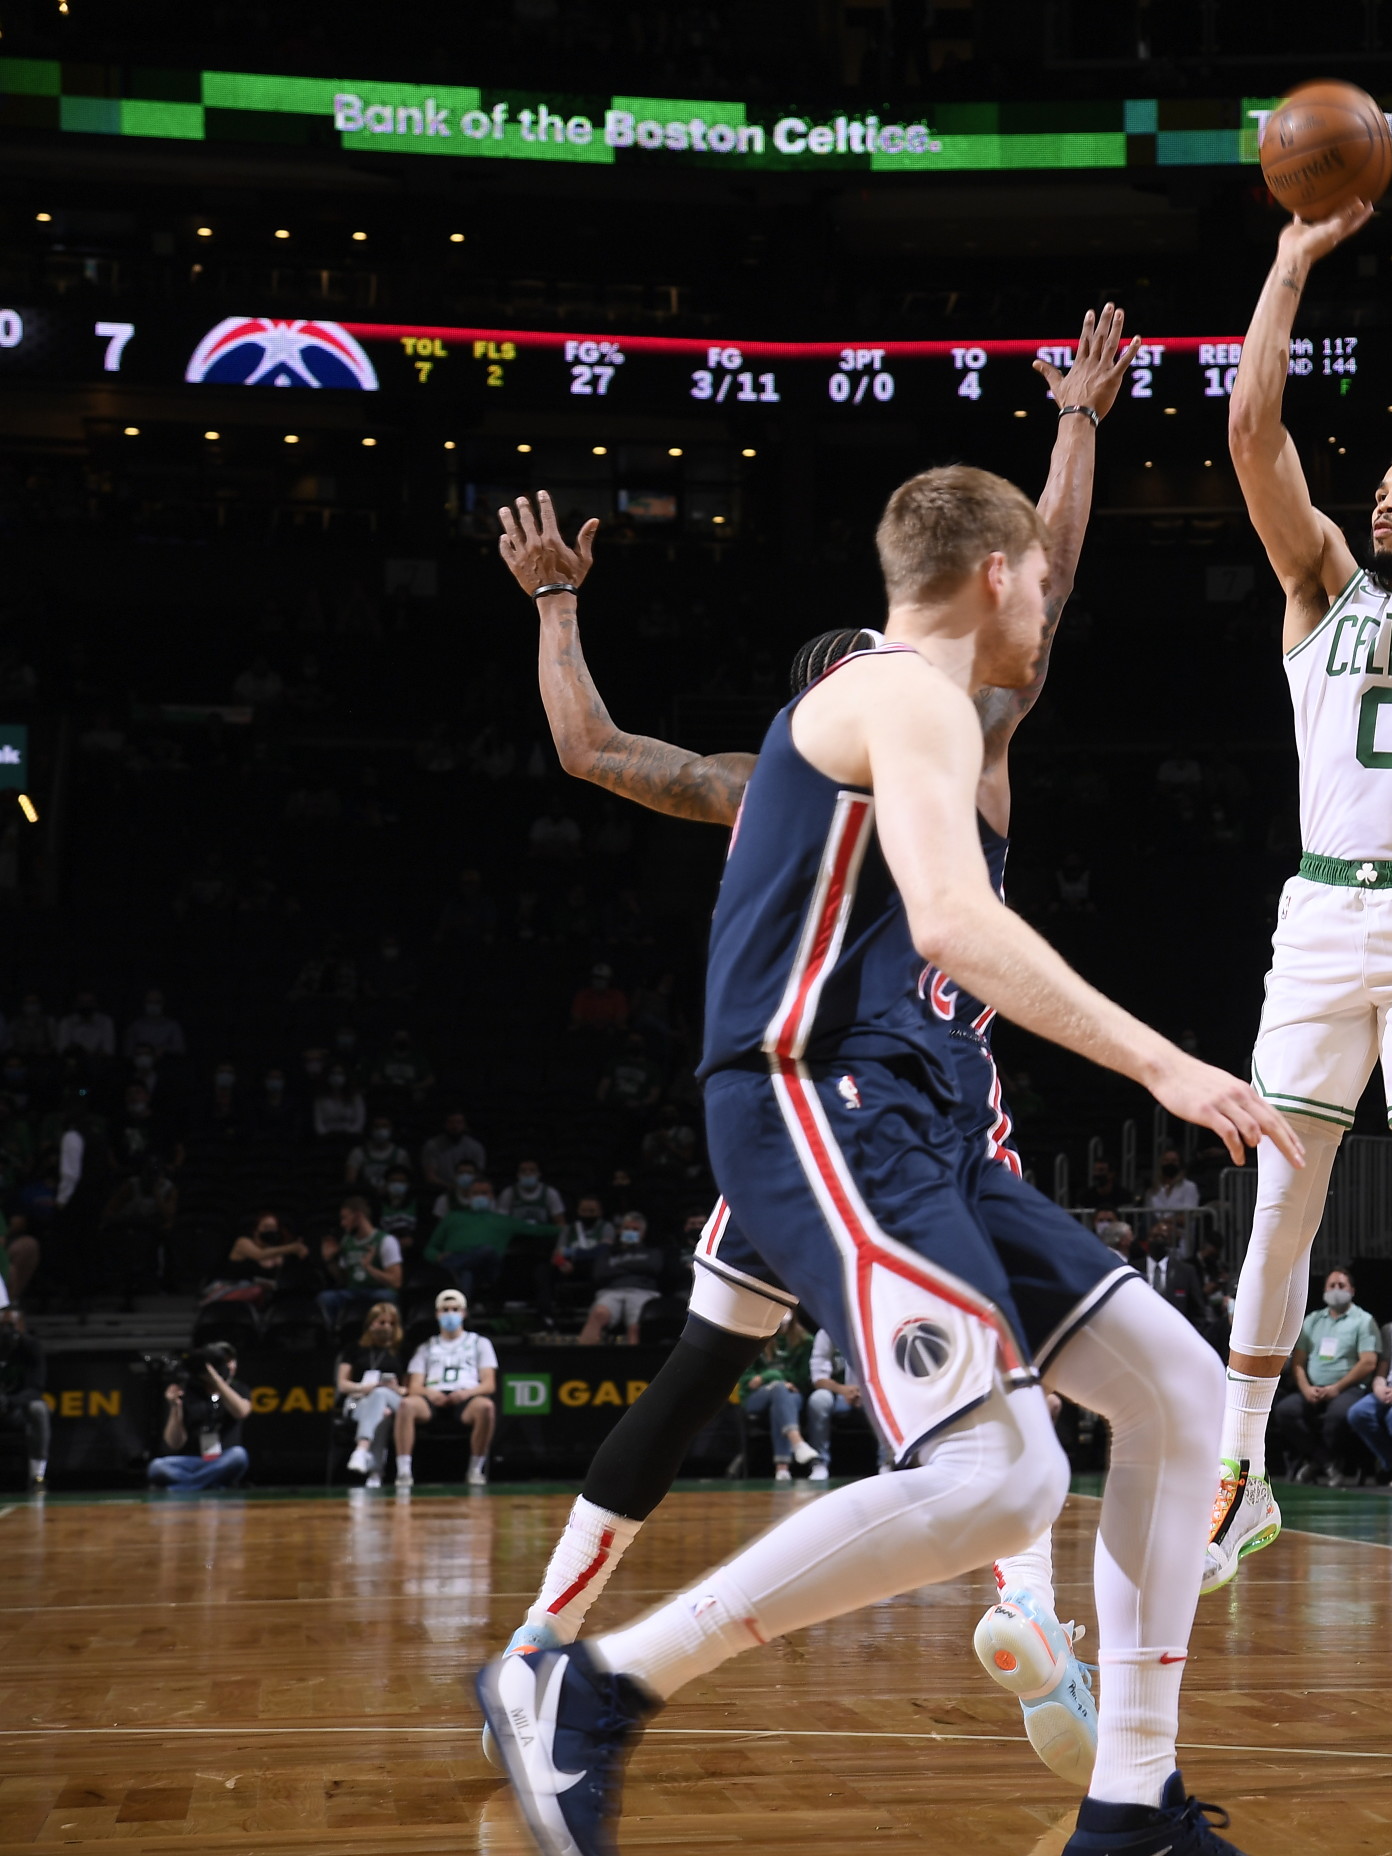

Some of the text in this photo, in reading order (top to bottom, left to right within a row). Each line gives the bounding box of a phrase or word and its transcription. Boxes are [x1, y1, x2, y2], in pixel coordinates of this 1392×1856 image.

[333, 92, 943, 154] Bank of the Boston Celtics.
[95, 321, 135, 371] 7
[402, 337, 448, 359] TOL
[473, 340, 516, 360] FLS
[564, 340, 624, 365] FG%
[707, 347, 743, 369] FG
[838, 349, 885, 371] 3PT
[952, 347, 987, 369] TO
[1199, 343, 1242, 366] REB
[1289, 337, 1358, 356] HA 117
[415, 361, 433, 383] 7
[486, 365, 504, 387] 2
[570, 366, 615, 395] 27
[691, 370, 781, 404] 3/11
[828, 372, 895, 405] 0/0
[958, 370, 982, 399] 4
[1131, 368, 1152, 398] 2
[1287, 356, 1358, 376] ND 144
[506, 1380, 547, 1407] TD
